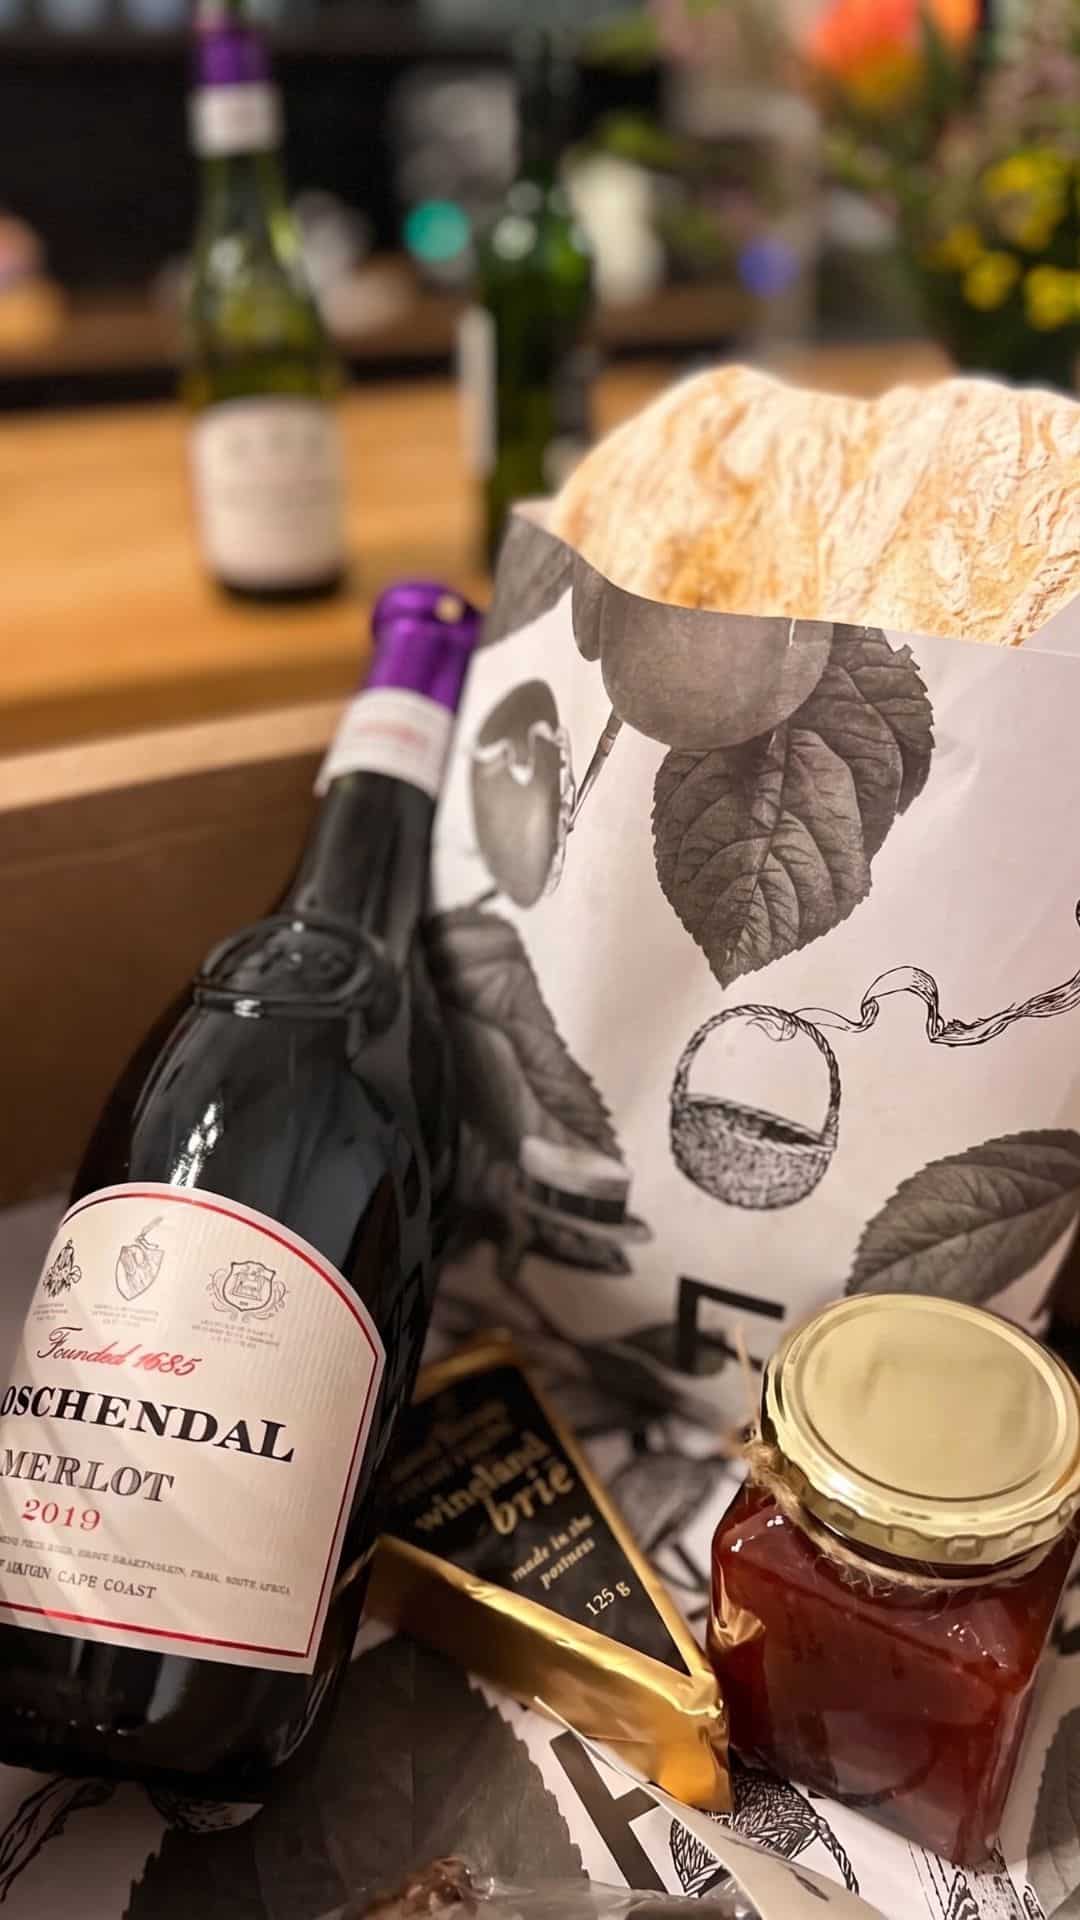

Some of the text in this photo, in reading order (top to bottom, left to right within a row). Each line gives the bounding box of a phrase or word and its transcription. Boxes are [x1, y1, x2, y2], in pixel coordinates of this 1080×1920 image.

[37, 1326, 202, 1377] Founded 1685
[0, 1448, 175, 1502] MERLOT
[22, 1498, 101, 1532] 2019
[512, 1545, 549, 1582] made
[57, 1569, 98, 1589] CAPE
[103, 1577, 157, 1599] COAST
[585, 1581, 631, 1616] 125 g
